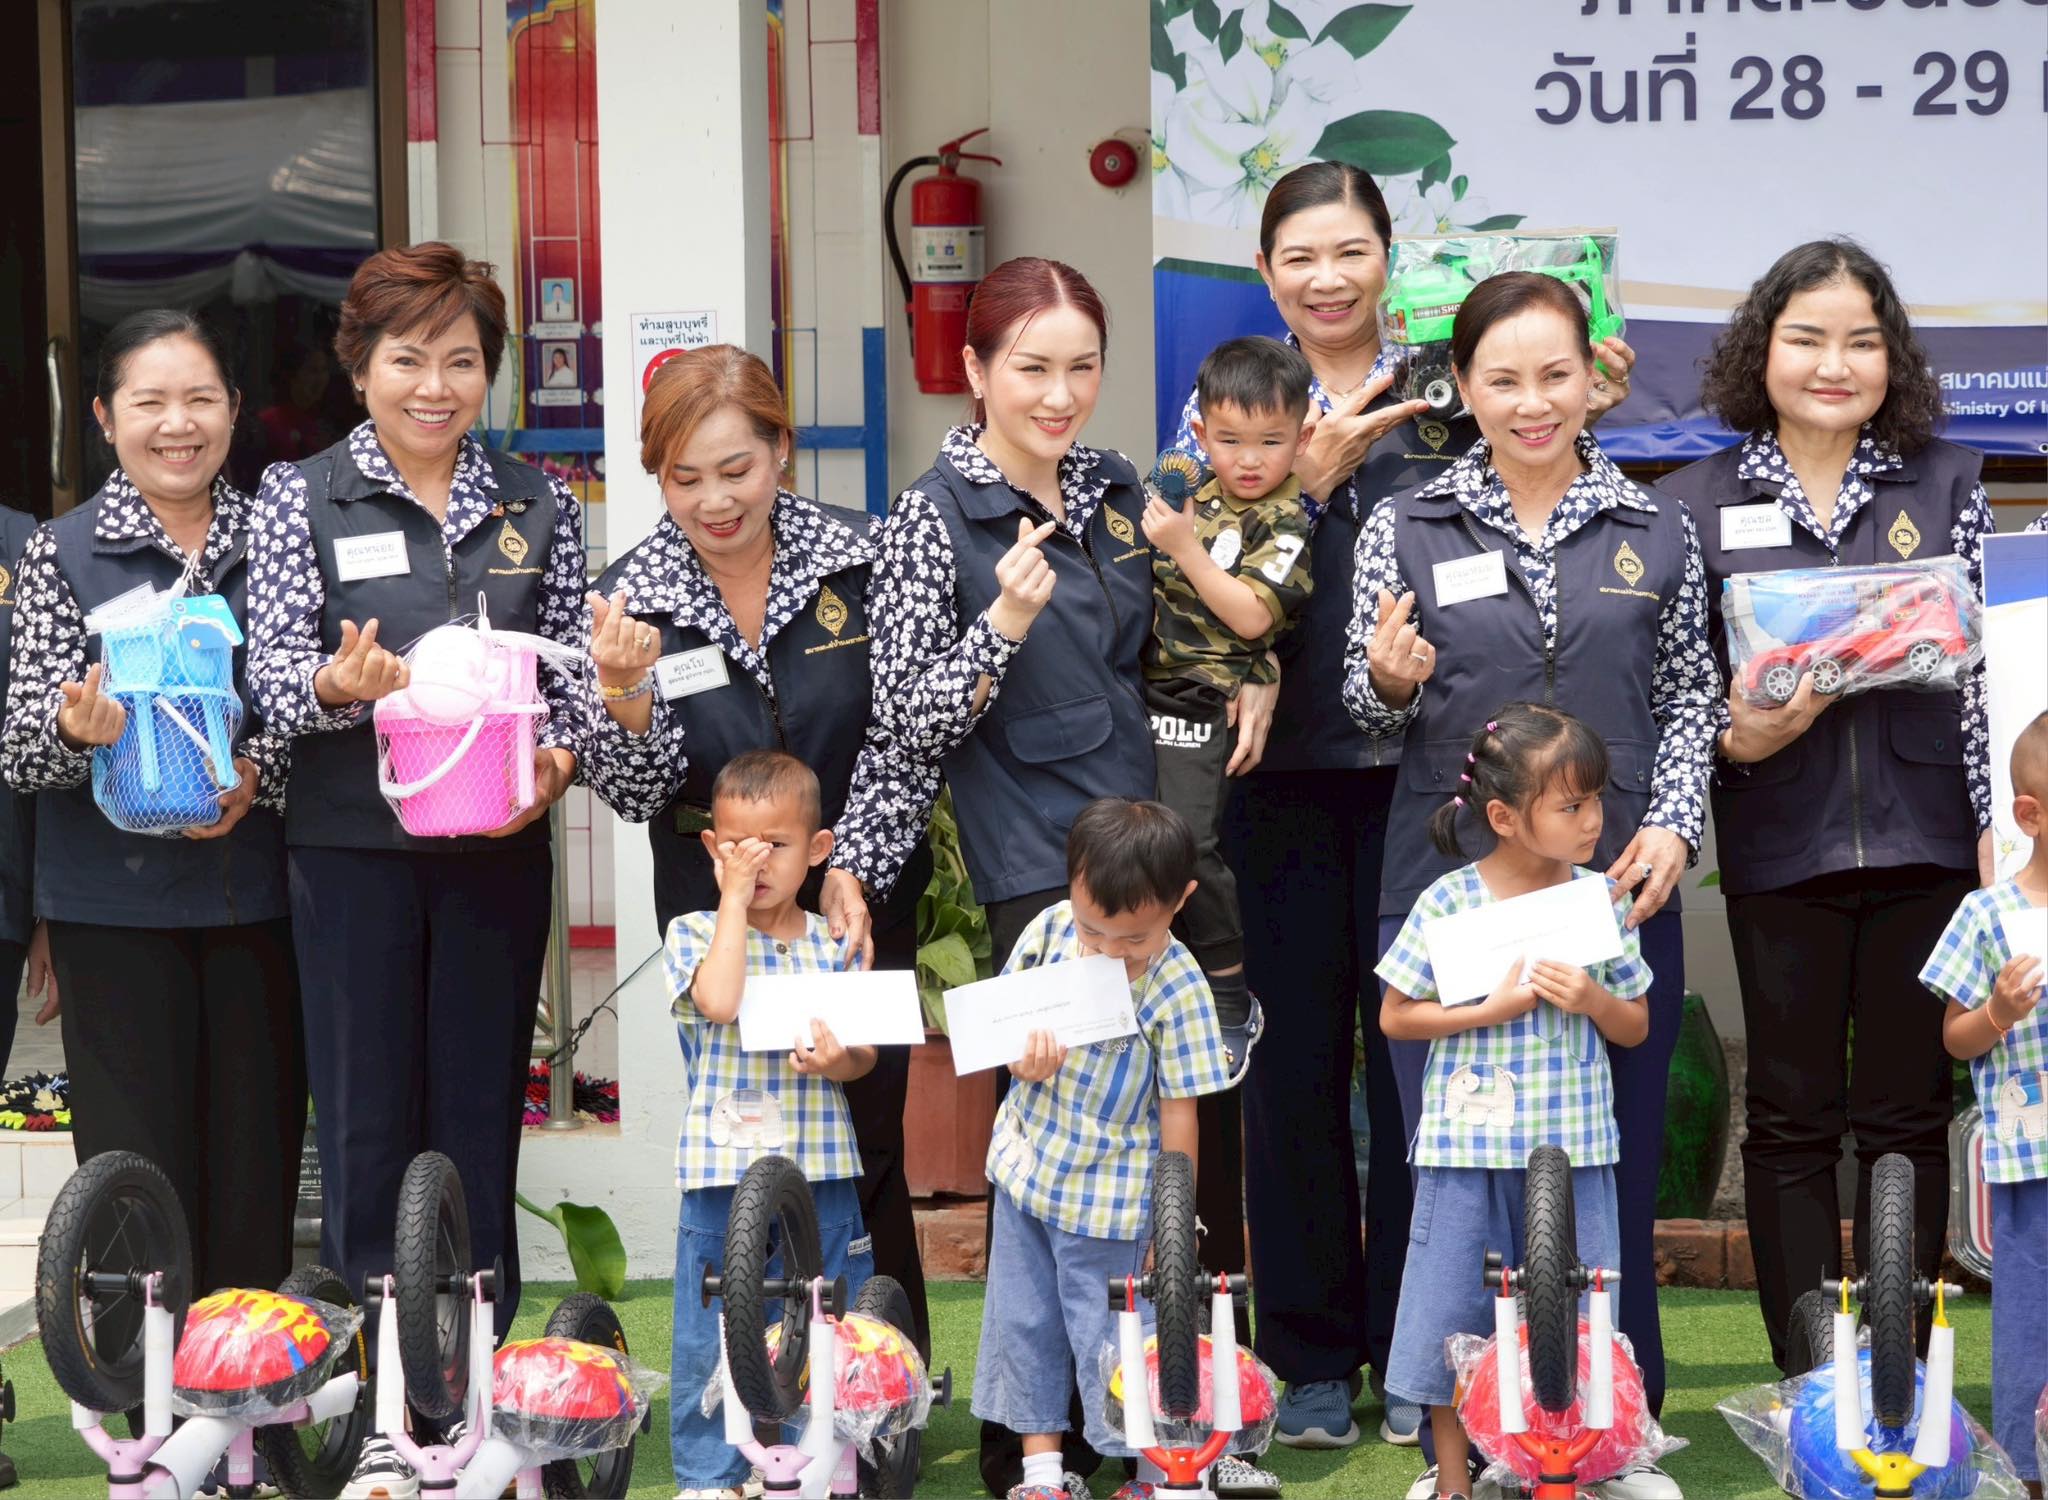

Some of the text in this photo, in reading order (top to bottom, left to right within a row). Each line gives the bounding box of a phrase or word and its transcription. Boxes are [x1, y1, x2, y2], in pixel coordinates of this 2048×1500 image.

[1534, 31, 1698, 125] วันที่
[1729, 54, 1827, 120] 28
[1856, 84, 1883, 98] -
[1912, 50, 2010, 116] 29
[639, 313, 708, 334] ห้ามสูบบุหรี่
[639, 332, 710, 348] และบุหรี่ไฟฟ้า
[2015, 400, 2036, 415] Of
[1261, 534, 1305, 585] 3
